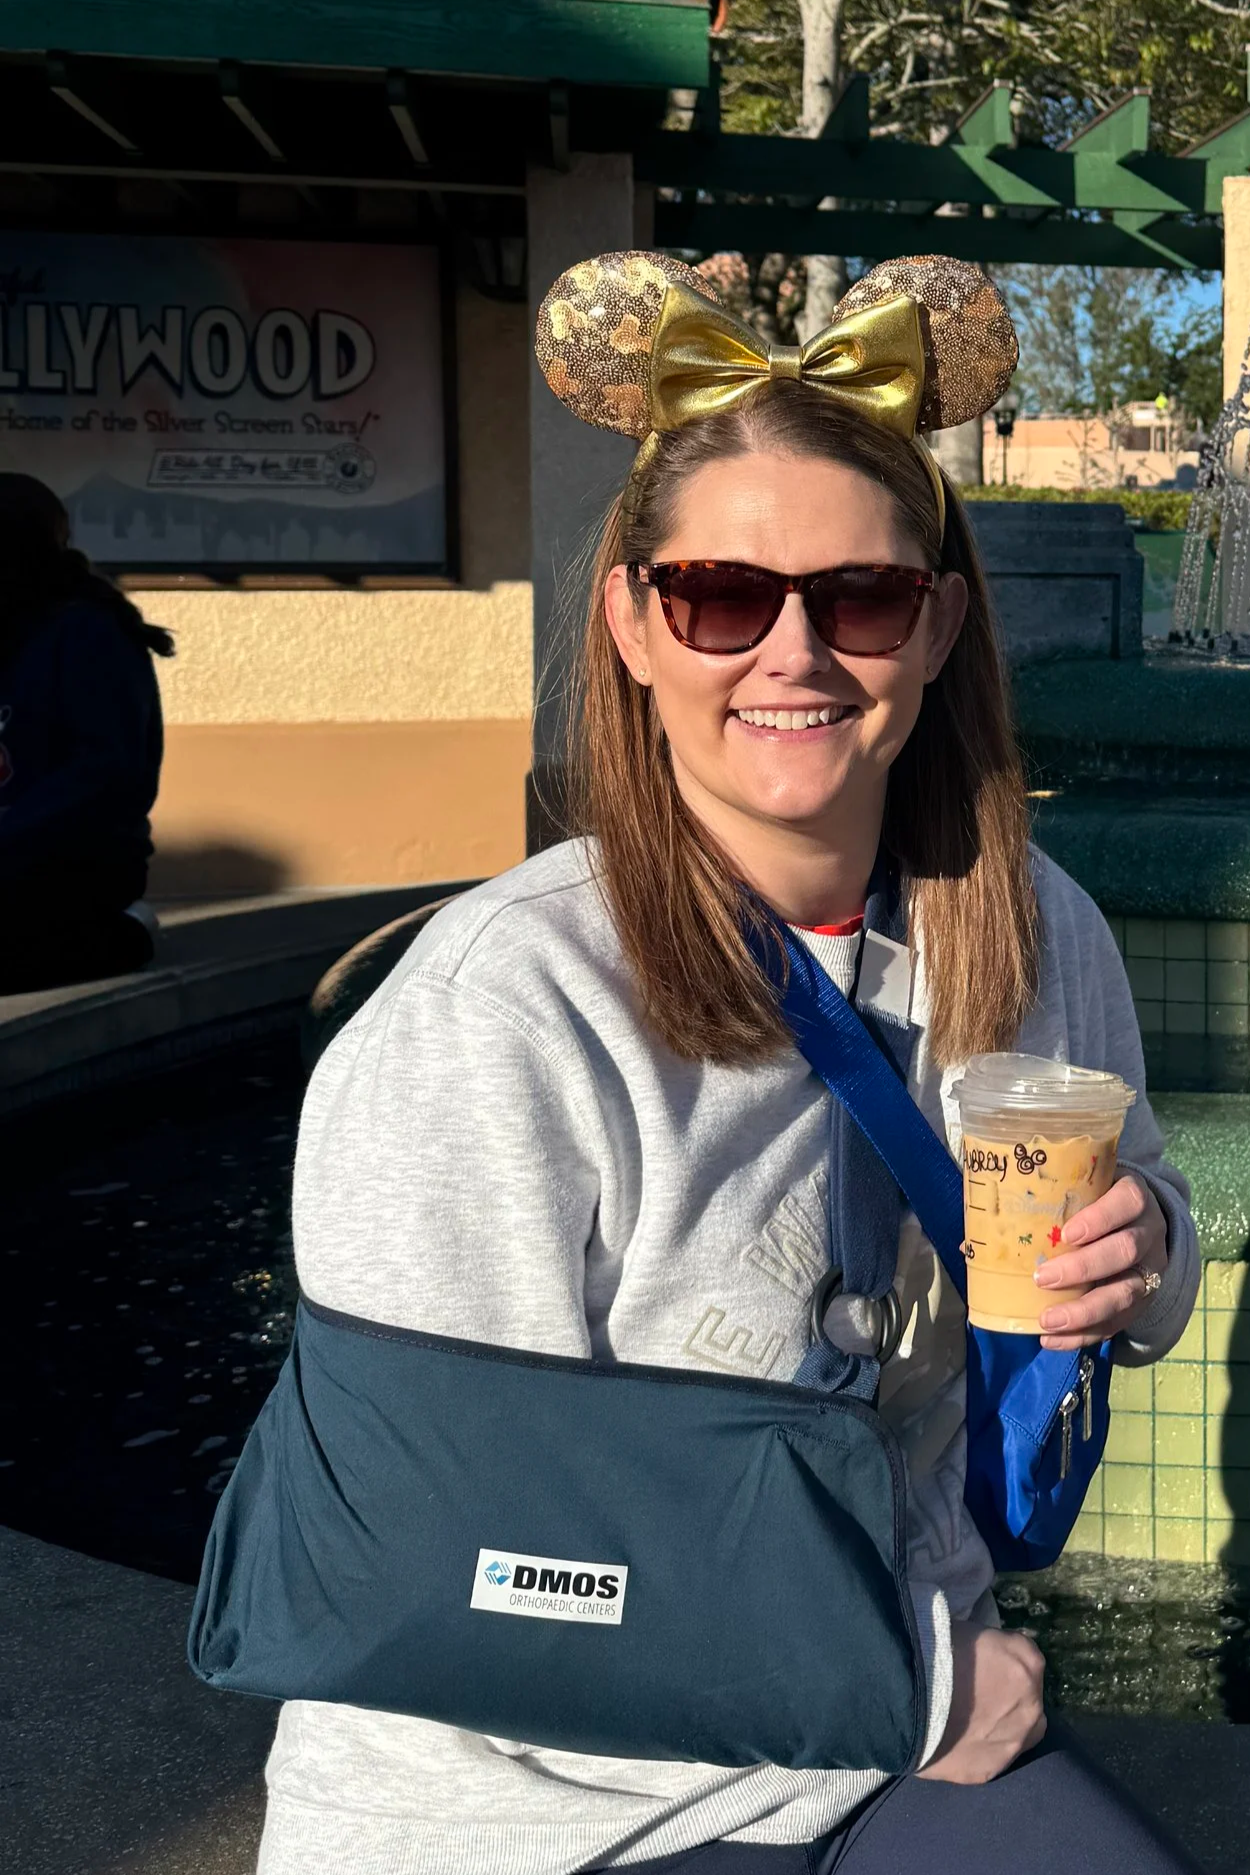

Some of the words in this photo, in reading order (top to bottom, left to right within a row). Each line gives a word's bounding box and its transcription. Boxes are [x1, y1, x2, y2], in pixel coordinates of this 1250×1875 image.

[71, 409, 100, 432] of
[102, 410, 138, 432] the
[144, 410, 206, 433] Silver
[214, 411, 294, 434] Screen
[512, 1565, 620, 1600] DMOS
[509, 1593, 574, 1613] ORTHOPAEDIC
[576, 1601, 616, 1617] CENTERS
